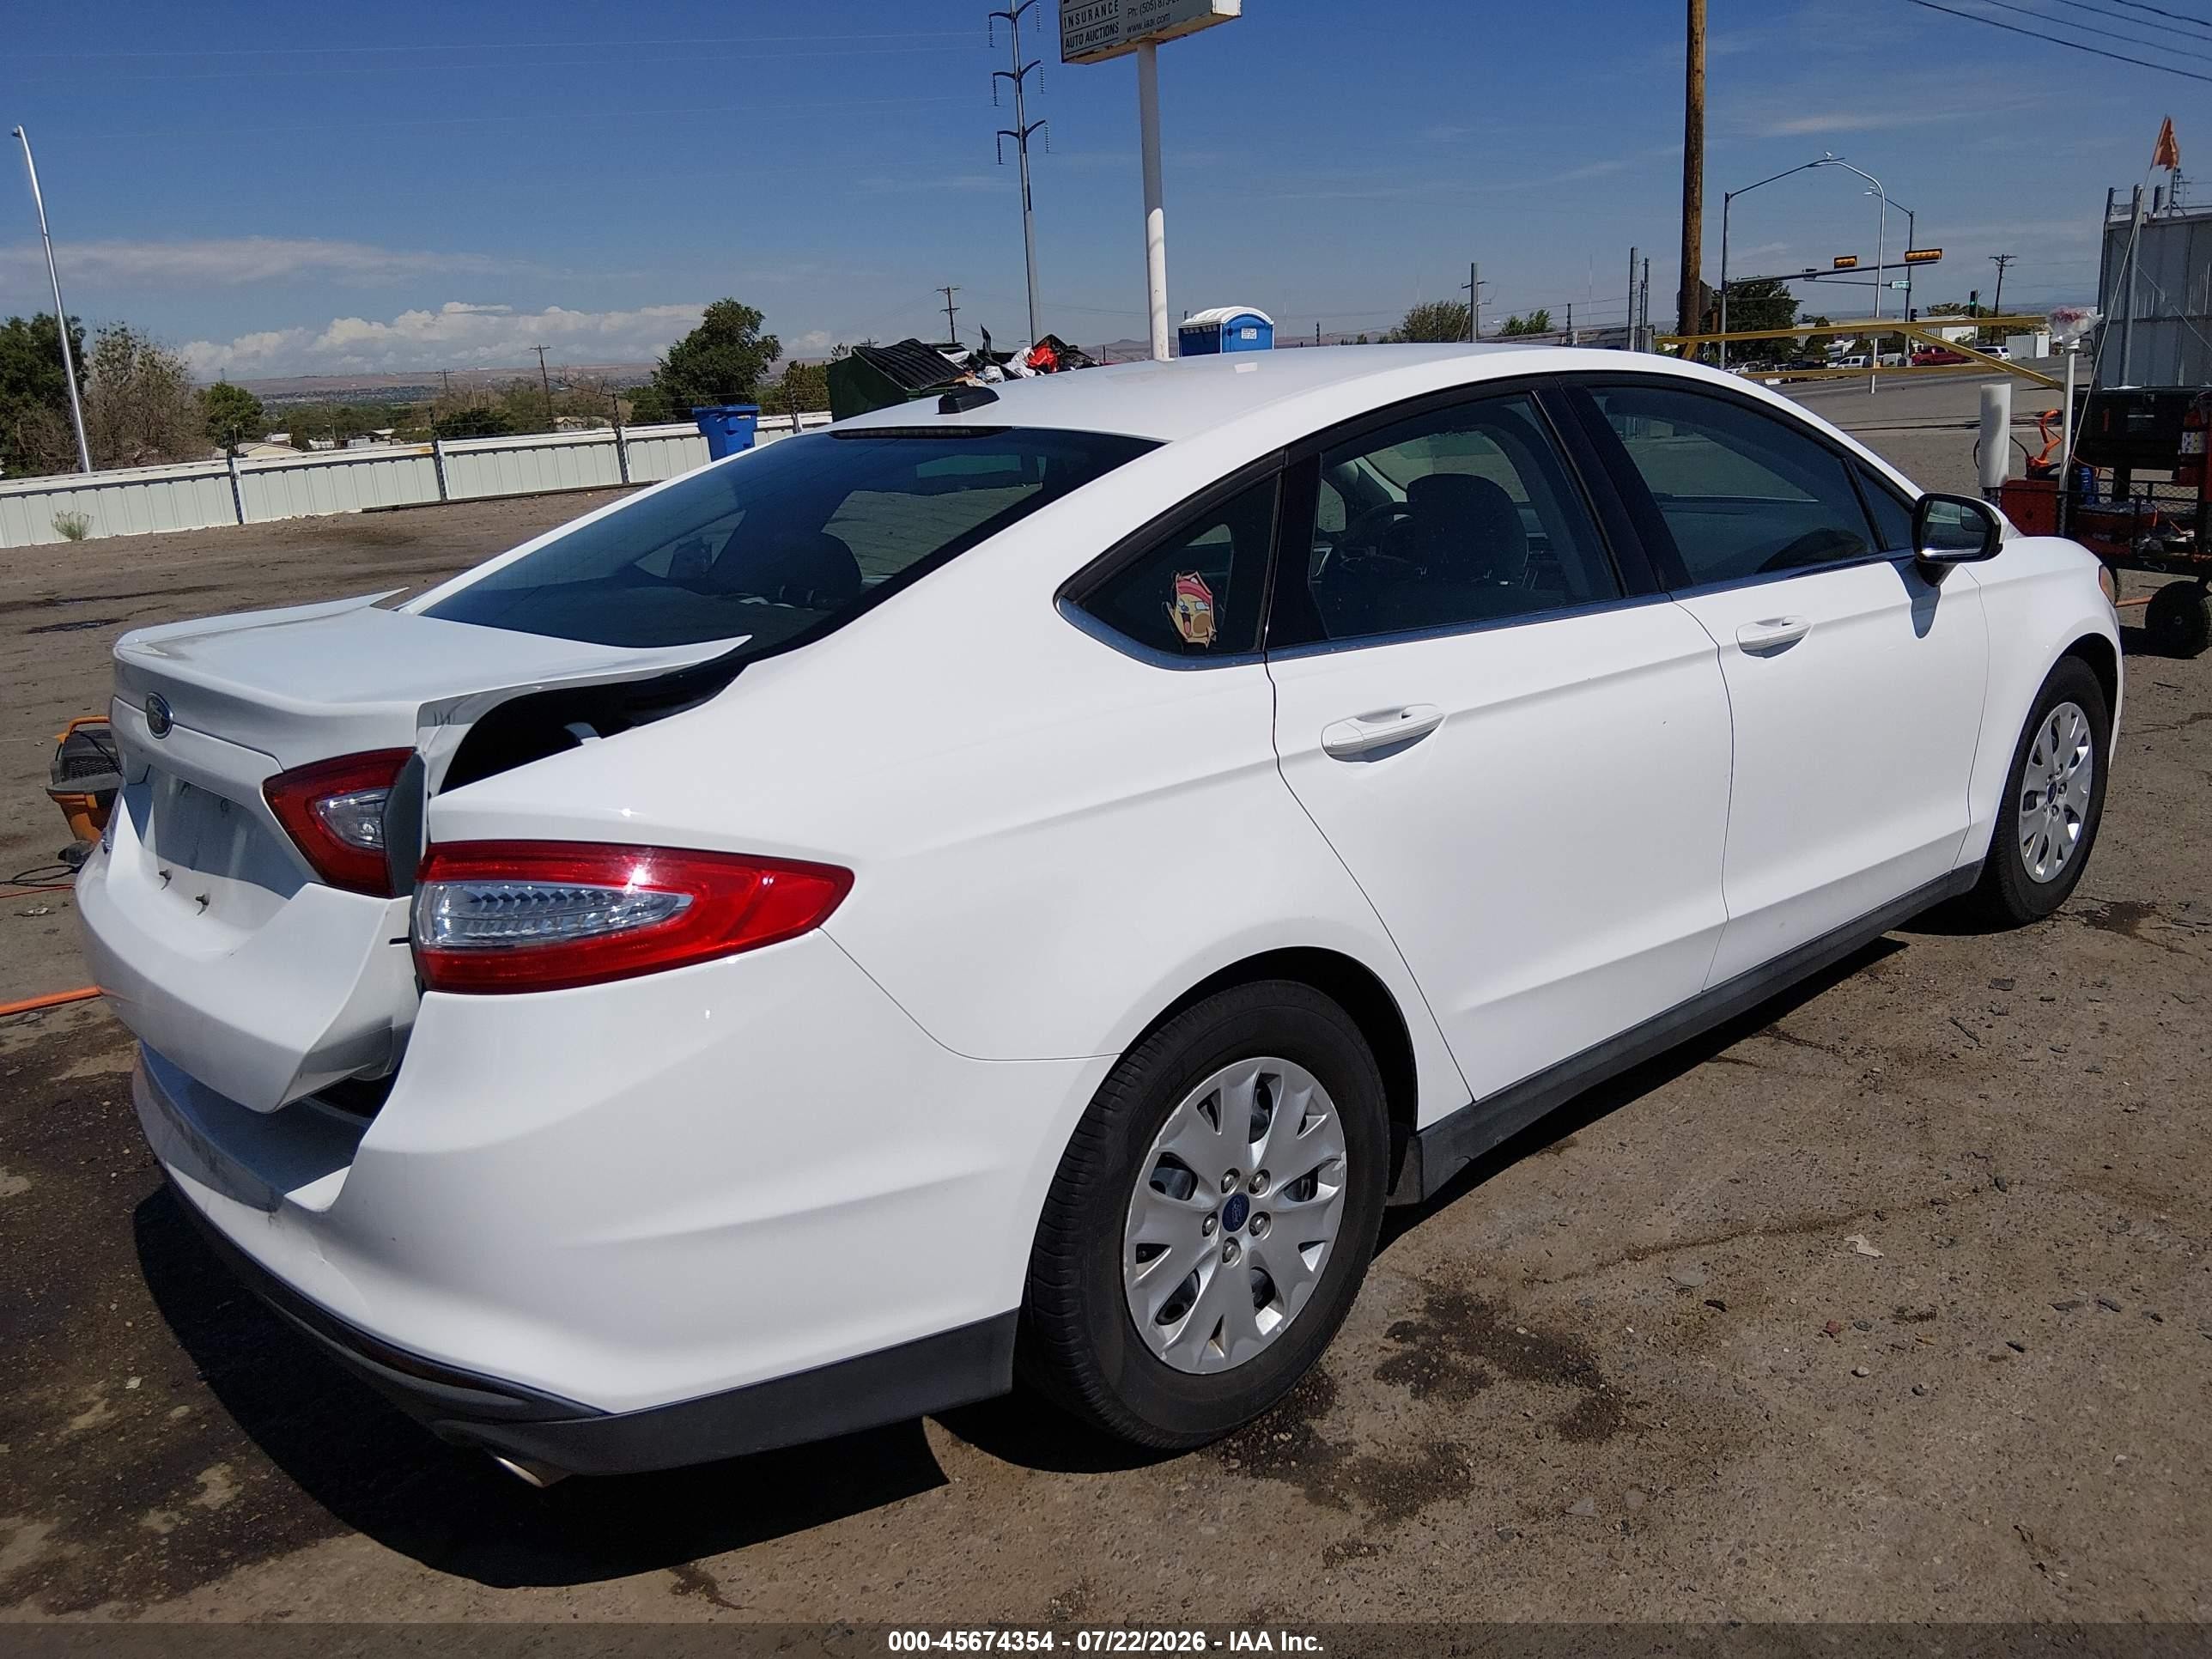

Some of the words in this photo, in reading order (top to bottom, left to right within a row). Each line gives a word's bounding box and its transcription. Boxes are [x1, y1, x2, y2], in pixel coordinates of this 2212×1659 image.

[1064, 1, 1119, 28] INSURANCE
[1139, 1, 1157, 15] (505)
[1065, 33, 1084, 49] AUTO
[1085, 21, 1119, 44] AUCTIONS
